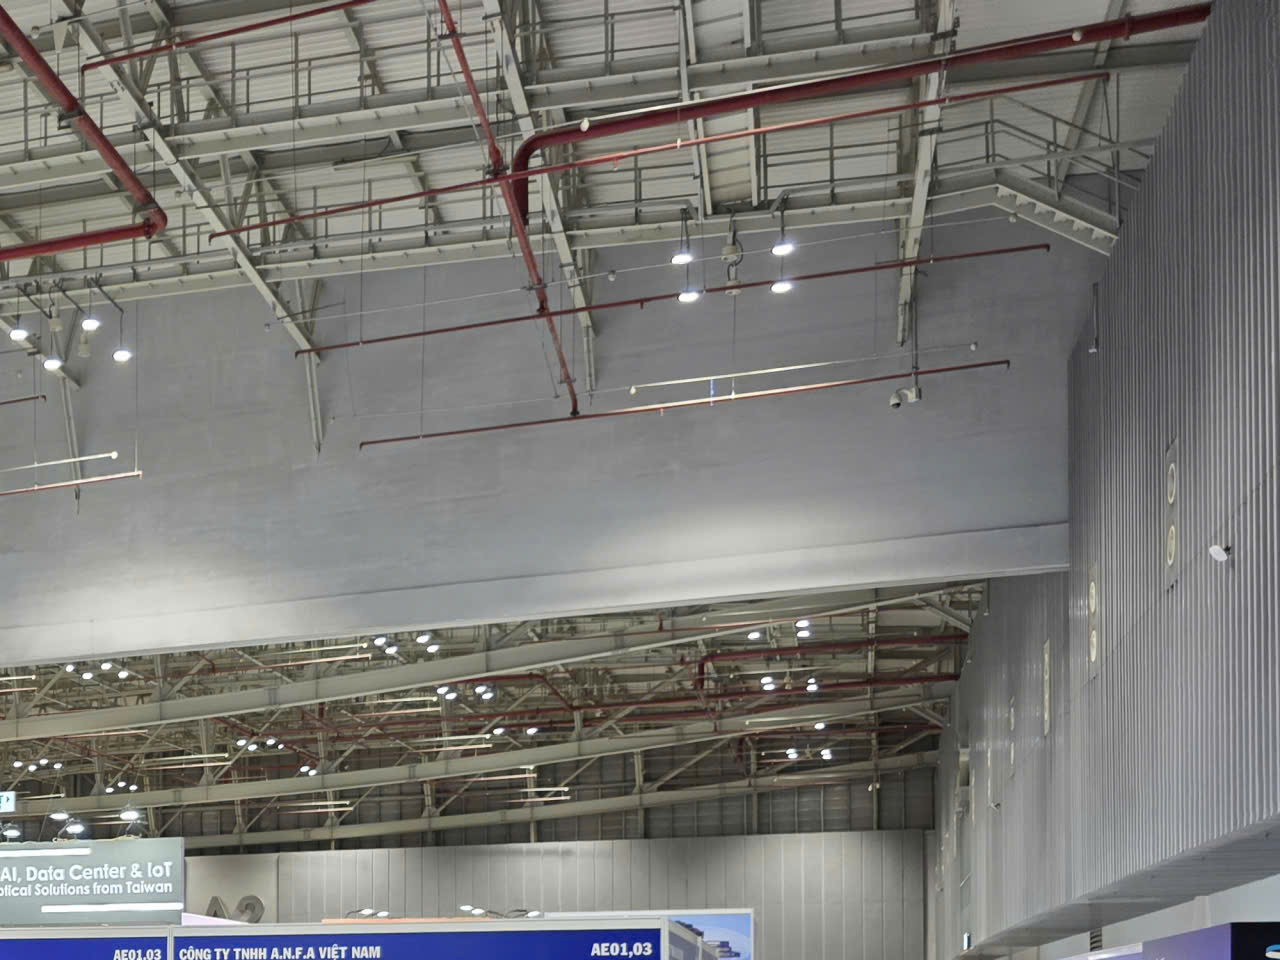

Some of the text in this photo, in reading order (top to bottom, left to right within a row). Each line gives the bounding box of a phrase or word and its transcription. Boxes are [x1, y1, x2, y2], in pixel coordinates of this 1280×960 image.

[0, 866, 21, 882] AI,
[26, 866, 65, 883] Data
[69, 863, 126, 881] Center
[131, 863, 143, 879] &
[147, 861, 173, 879] IoT
[34, 881, 89, 896] Solutions
[92, 880, 123, 895] from
[126, 880, 173, 894] Taiwan
[179, 946, 211, 960] CÔNG
[214, 948, 230, 960] TY
[233, 948, 267, 960] TNHH
[270, 947, 315, 960] A.N.F.A
[351, 946, 381, 959] NAM
[591, 943, 652, 957] AE01,03
